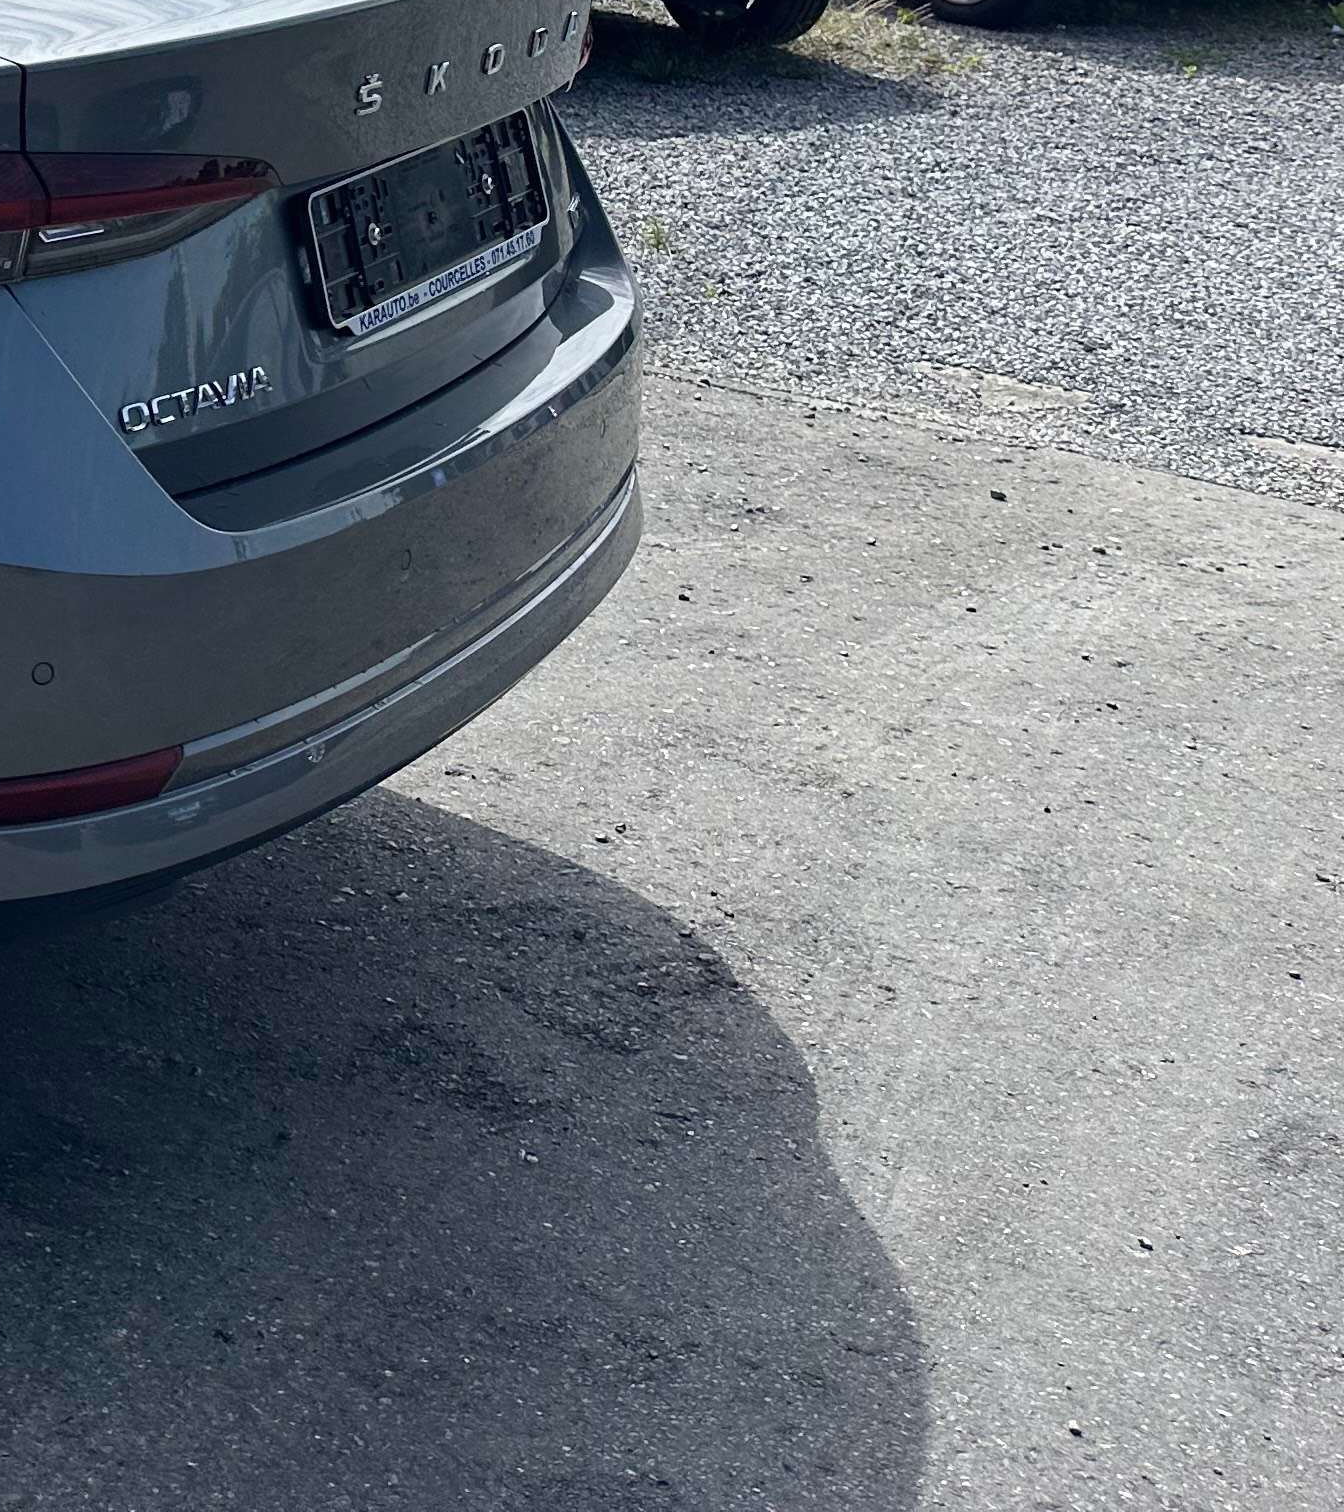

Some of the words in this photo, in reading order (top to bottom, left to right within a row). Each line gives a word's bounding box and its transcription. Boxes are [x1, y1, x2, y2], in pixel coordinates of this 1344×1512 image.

[359, 292, 420, 330] KARAUTO.be
[428, 255, 486, 297] COURCELLES
[120, 366, 273, 433] OCTAVIA
